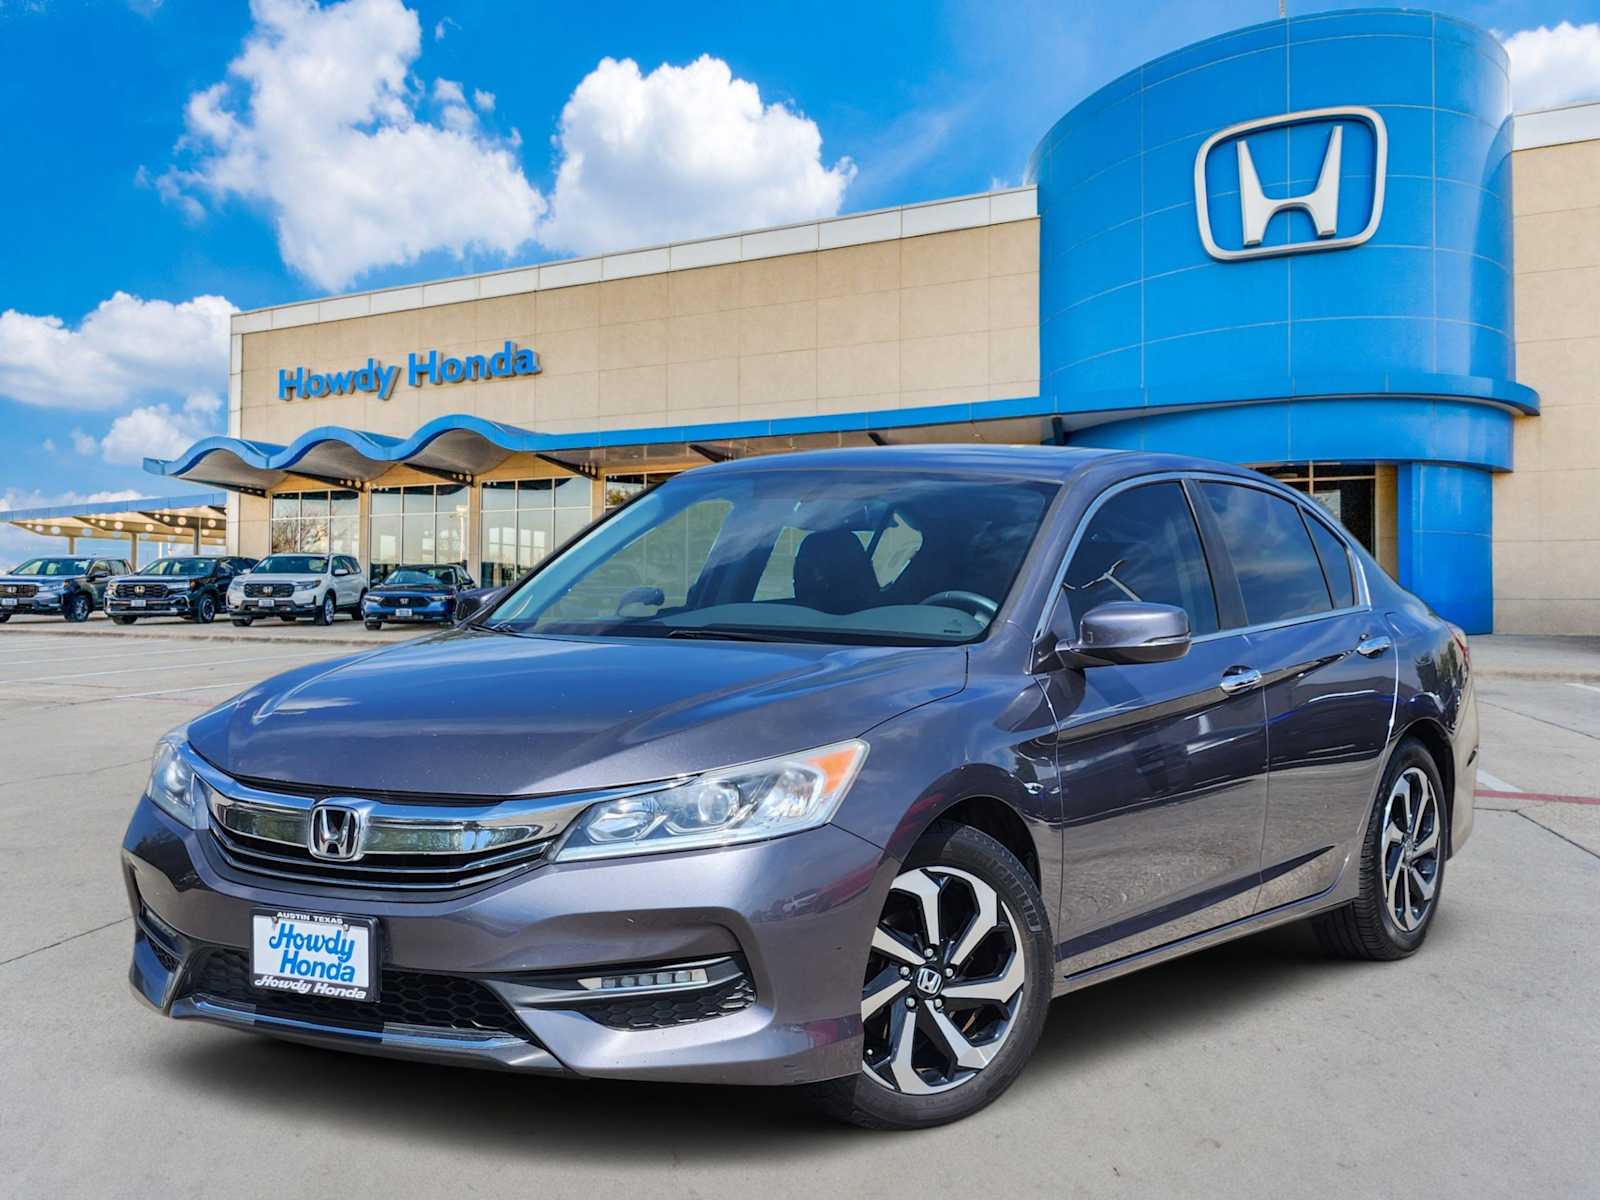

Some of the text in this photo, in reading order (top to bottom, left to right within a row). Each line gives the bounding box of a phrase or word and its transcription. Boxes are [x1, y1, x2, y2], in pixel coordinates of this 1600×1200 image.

[278, 340, 542, 401] Howdy Honda
[277, 912, 343, 924] AUSTIN TEXAS
[269, 923, 355, 962] Howdy
[280, 950, 355, 982] Honda
[255, 976, 366, 999] Howdy Honda
